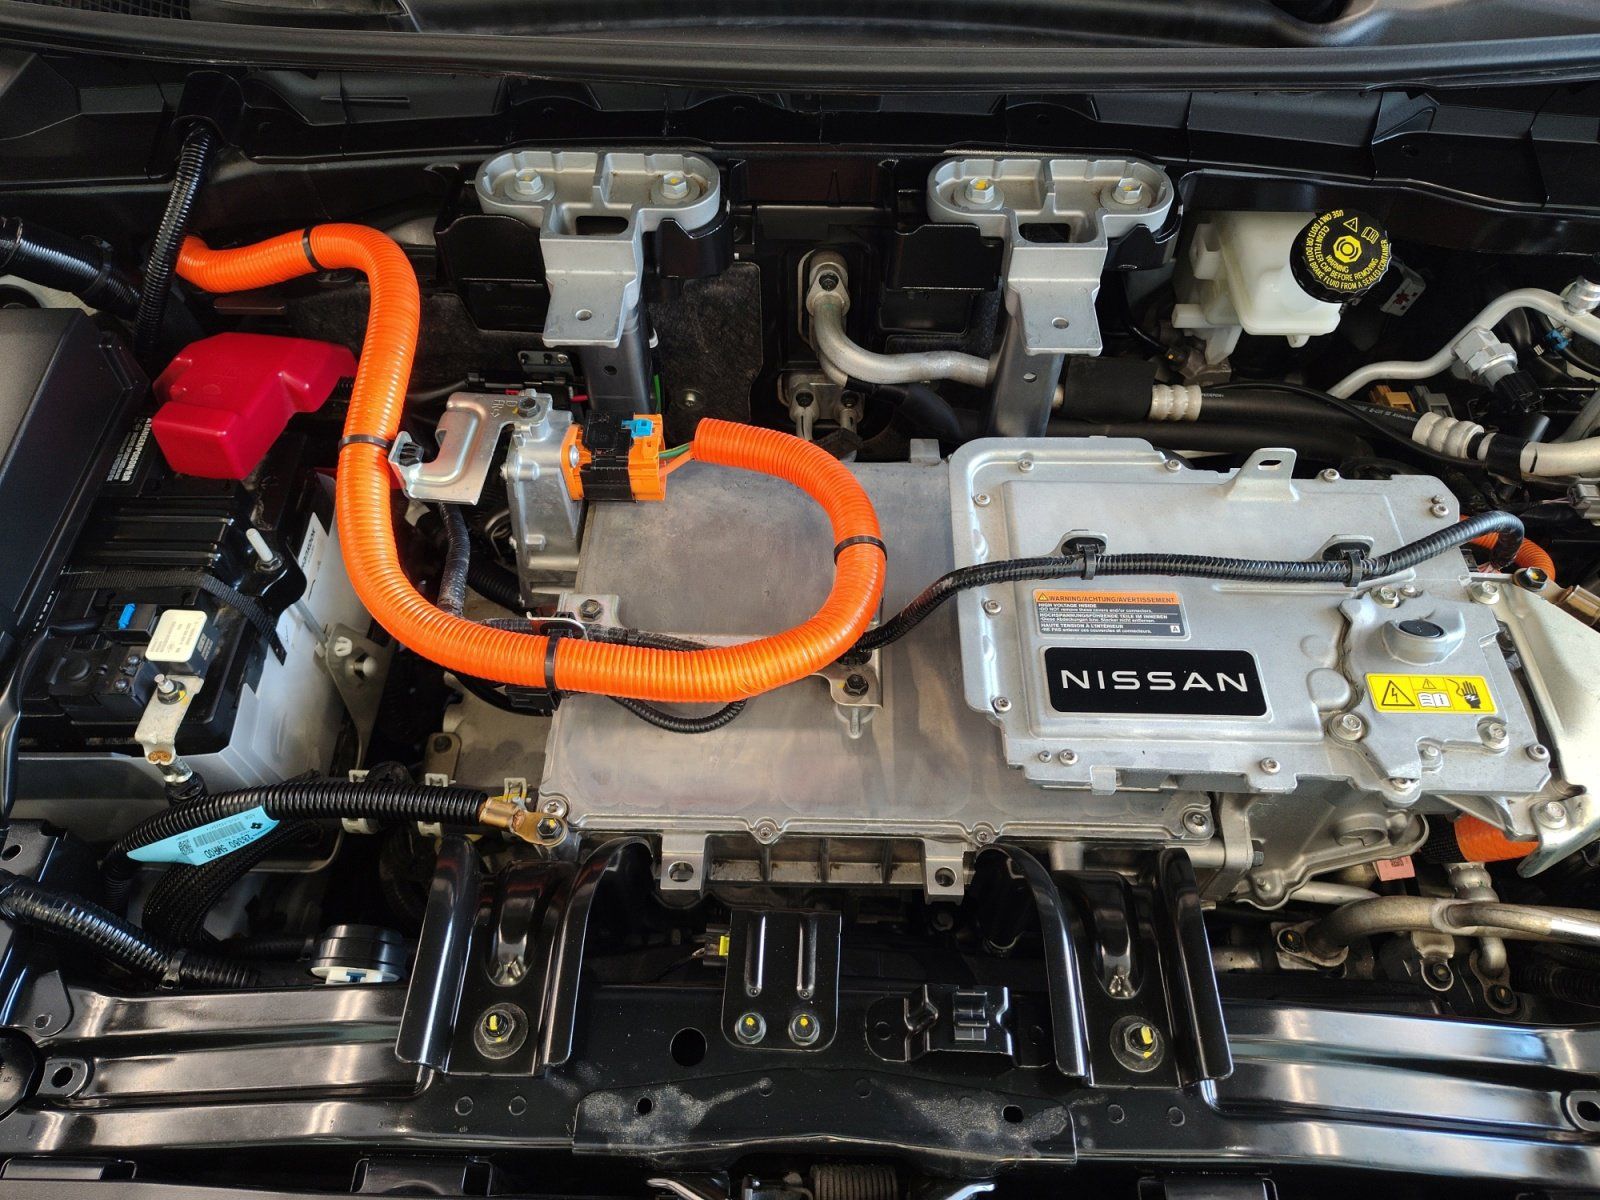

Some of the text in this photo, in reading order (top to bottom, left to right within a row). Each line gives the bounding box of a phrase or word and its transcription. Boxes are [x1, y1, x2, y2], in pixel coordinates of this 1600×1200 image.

[1318, 214, 1332, 226] ONLY
[1332, 210, 1344, 219] USE
[1306, 238, 1314, 246] OR
[1314, 225, 1379, 281] CLEAN FILLER CAP BEFORE REMOVING
[1378, 239, 1389, 271] CONTAINER
[1310, 262, 1324, 279] BRAKE
[1325, 254, 1349, 273] WARNING
[1323, 276, 1340, 288] FLUID
[1362, 270, 1382, 286] SEALED
[1060, 670, 1248, 692] NISSAN
